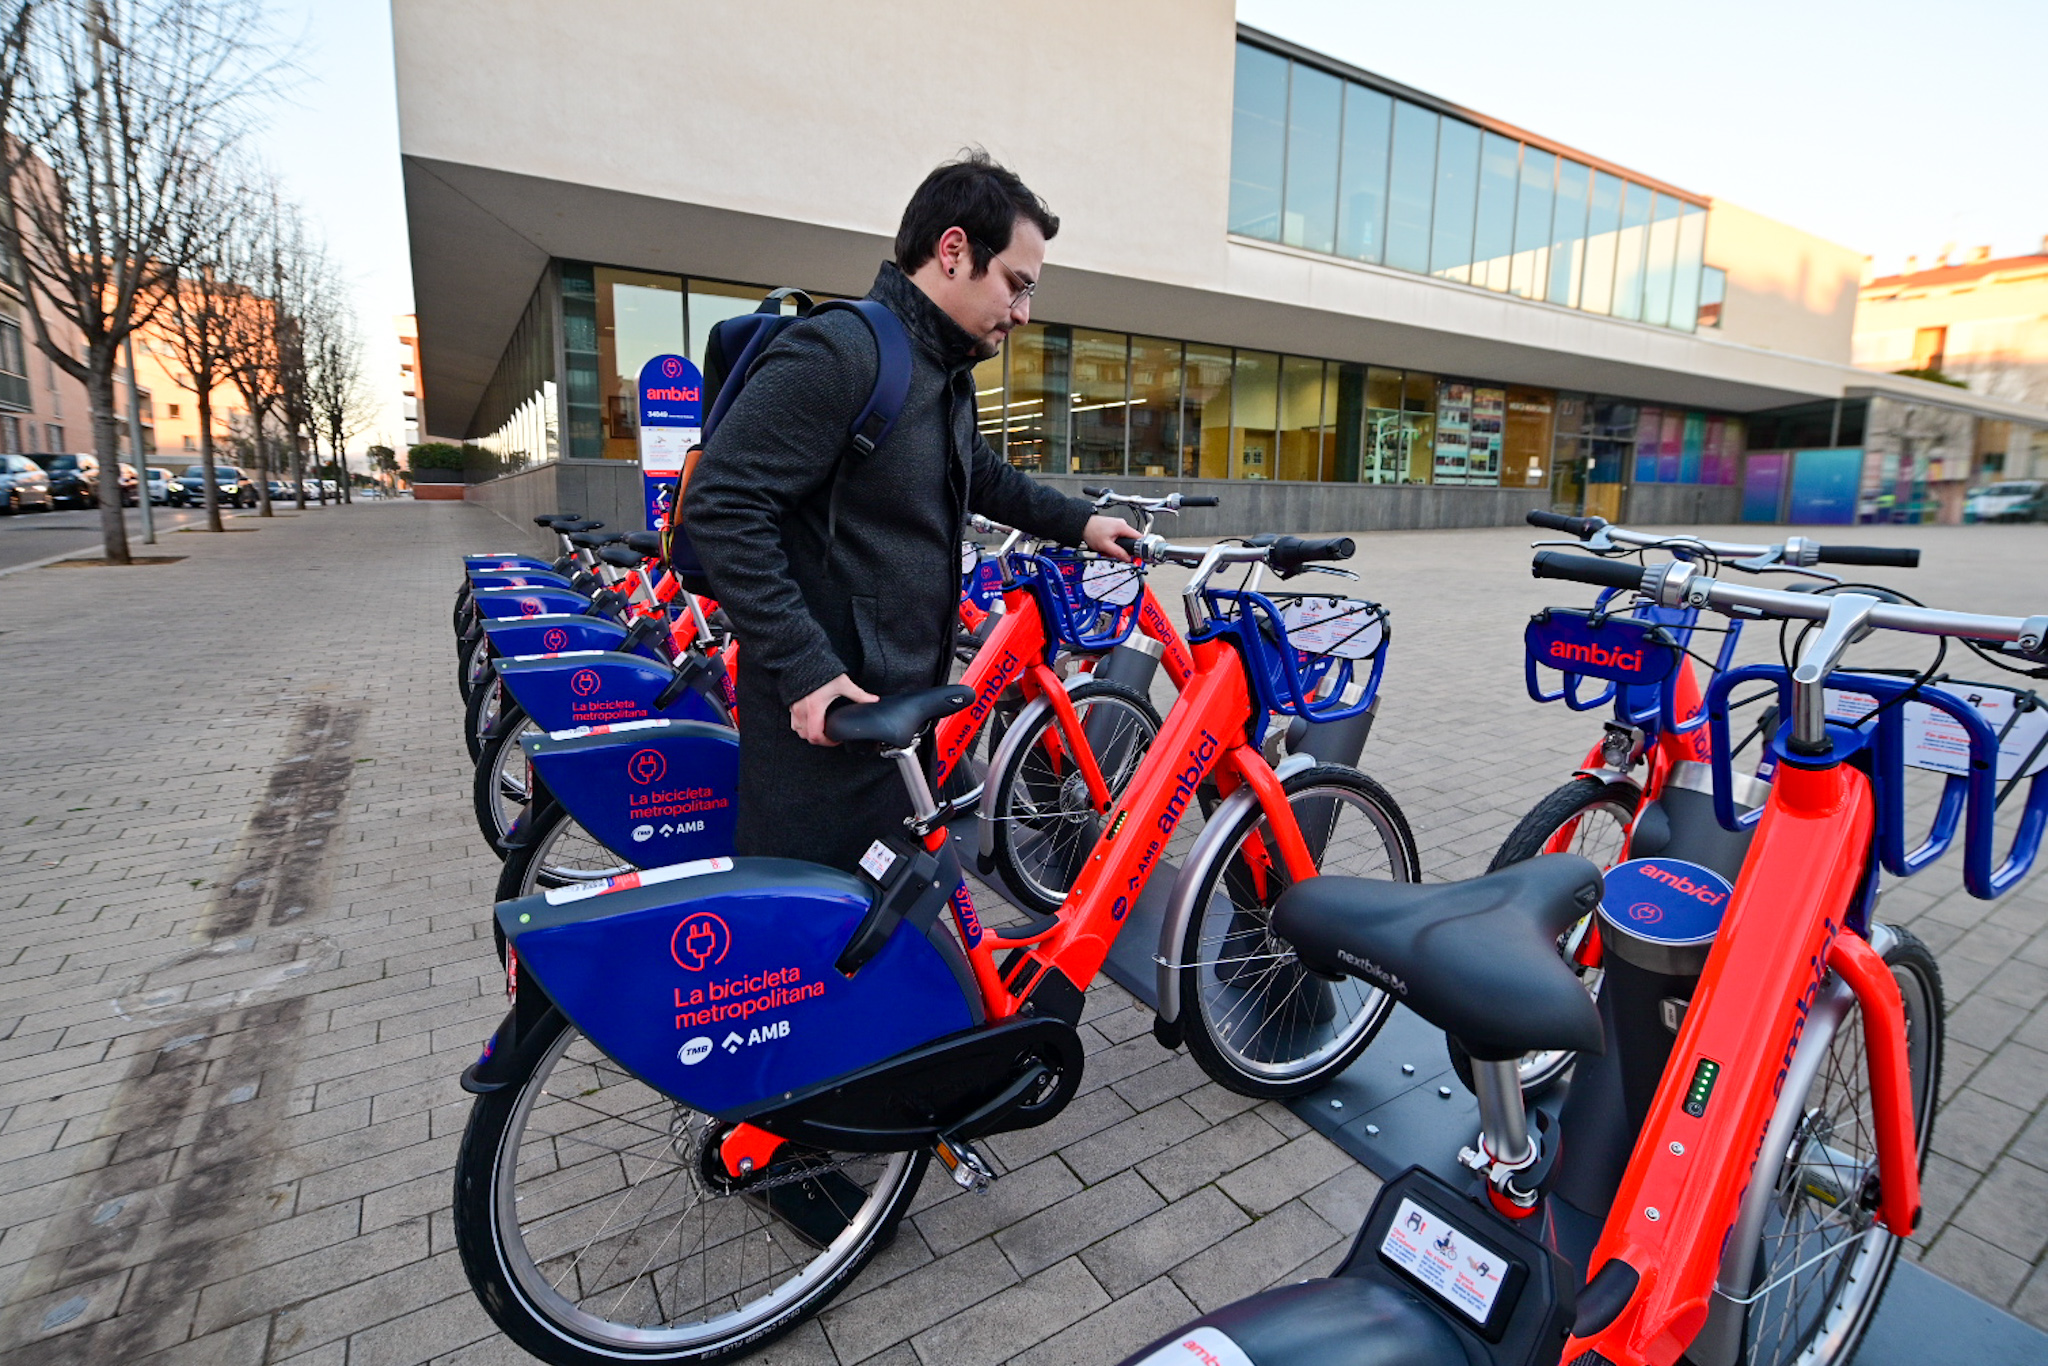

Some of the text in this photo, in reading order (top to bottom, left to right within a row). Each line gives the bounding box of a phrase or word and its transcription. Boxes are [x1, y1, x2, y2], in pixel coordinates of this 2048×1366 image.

[647, 386, 699, 401] ambici
[1144, 603, 1175, 646] ambici
[1550, 640, 1644, 672] ambici
[971, 650, 1019, 721] ambici
[572, 700, 636, 711] La bicicleta
[572, 710, 648, 721] metropolitana
[956, 724, 971, 746] AMB
[630, 787, 713, 806] La bicicleta
[1158, 730, 1219, 834] ambici
[630, 798, 729, 819] metropolitana
[676, 820, 705, 834] AMB
[1139, 841, 1160, 874] AMB
[1639, 864, 1727, 906] ambici
[1337, 949, 1390, 984] nextbike
[674, 967, 802, 1008] La bicicleta
[675, 981, 826, 1030] metropolitana
[747, 1020, 791, 1046] AMB
[1182, 1340, 1220, 1366] amb
